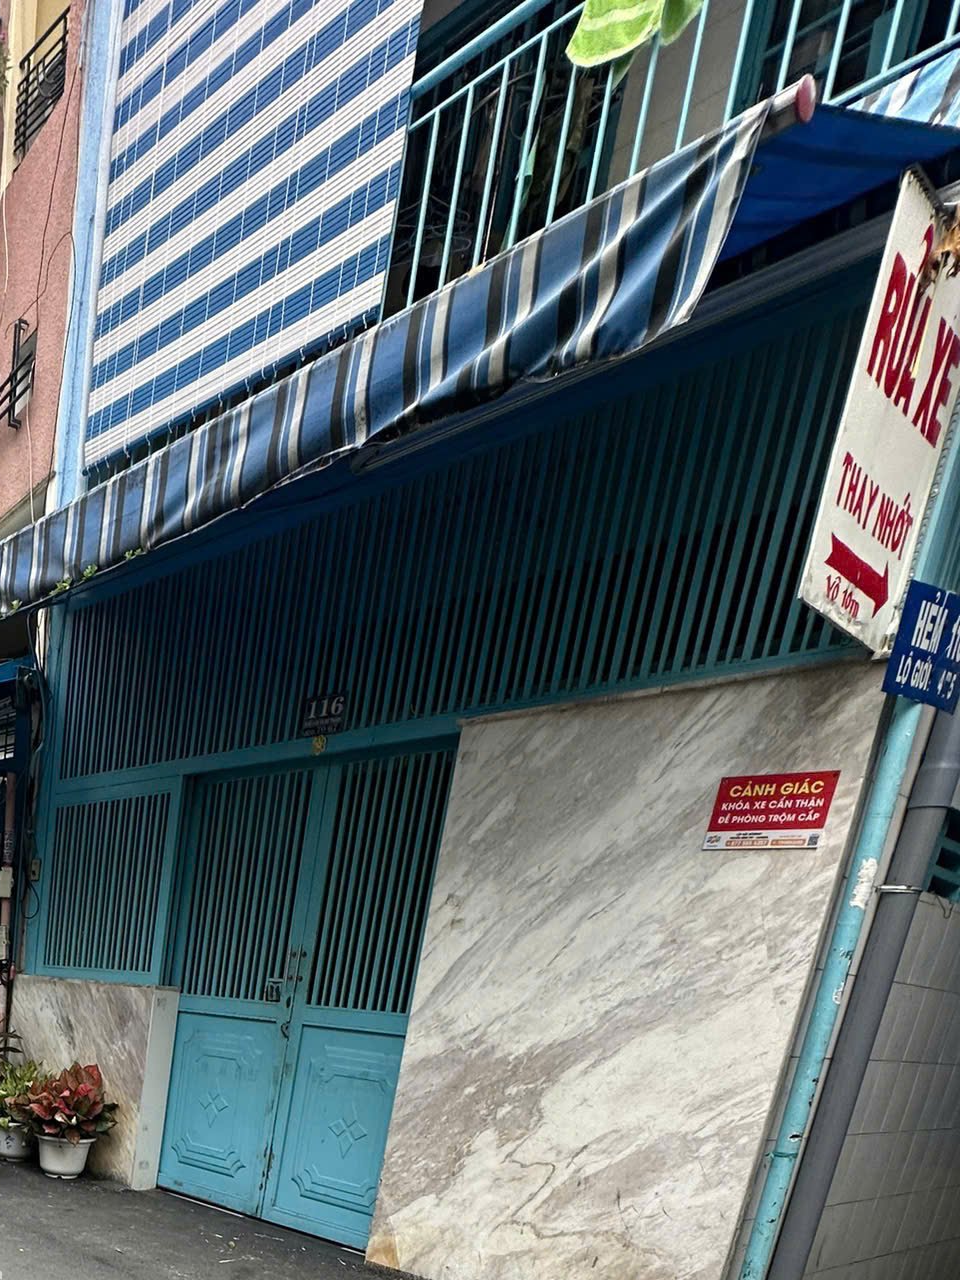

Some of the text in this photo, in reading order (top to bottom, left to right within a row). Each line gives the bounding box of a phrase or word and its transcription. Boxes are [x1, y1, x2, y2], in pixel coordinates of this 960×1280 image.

[912, 316, 960, 449] XE
[836, 451, 914, 561] THAY NHỚT
[841, 588, 860, 620] 10m
[911, 591, 960, 662] HẺM 11
[895, 650, 914, 689] LỘ
[308, 696, 345, 720] 116
[721, 799, 751, 812] KHÓA
[753, 800, 767, 810] XE
[795, 796, 825, 811] THẬN
[729, 778, 825, 798] CẢNH GIÁC
[731, 813, 766, 824] PHÒNG
[768, 812, 796, 824] TRỘM
